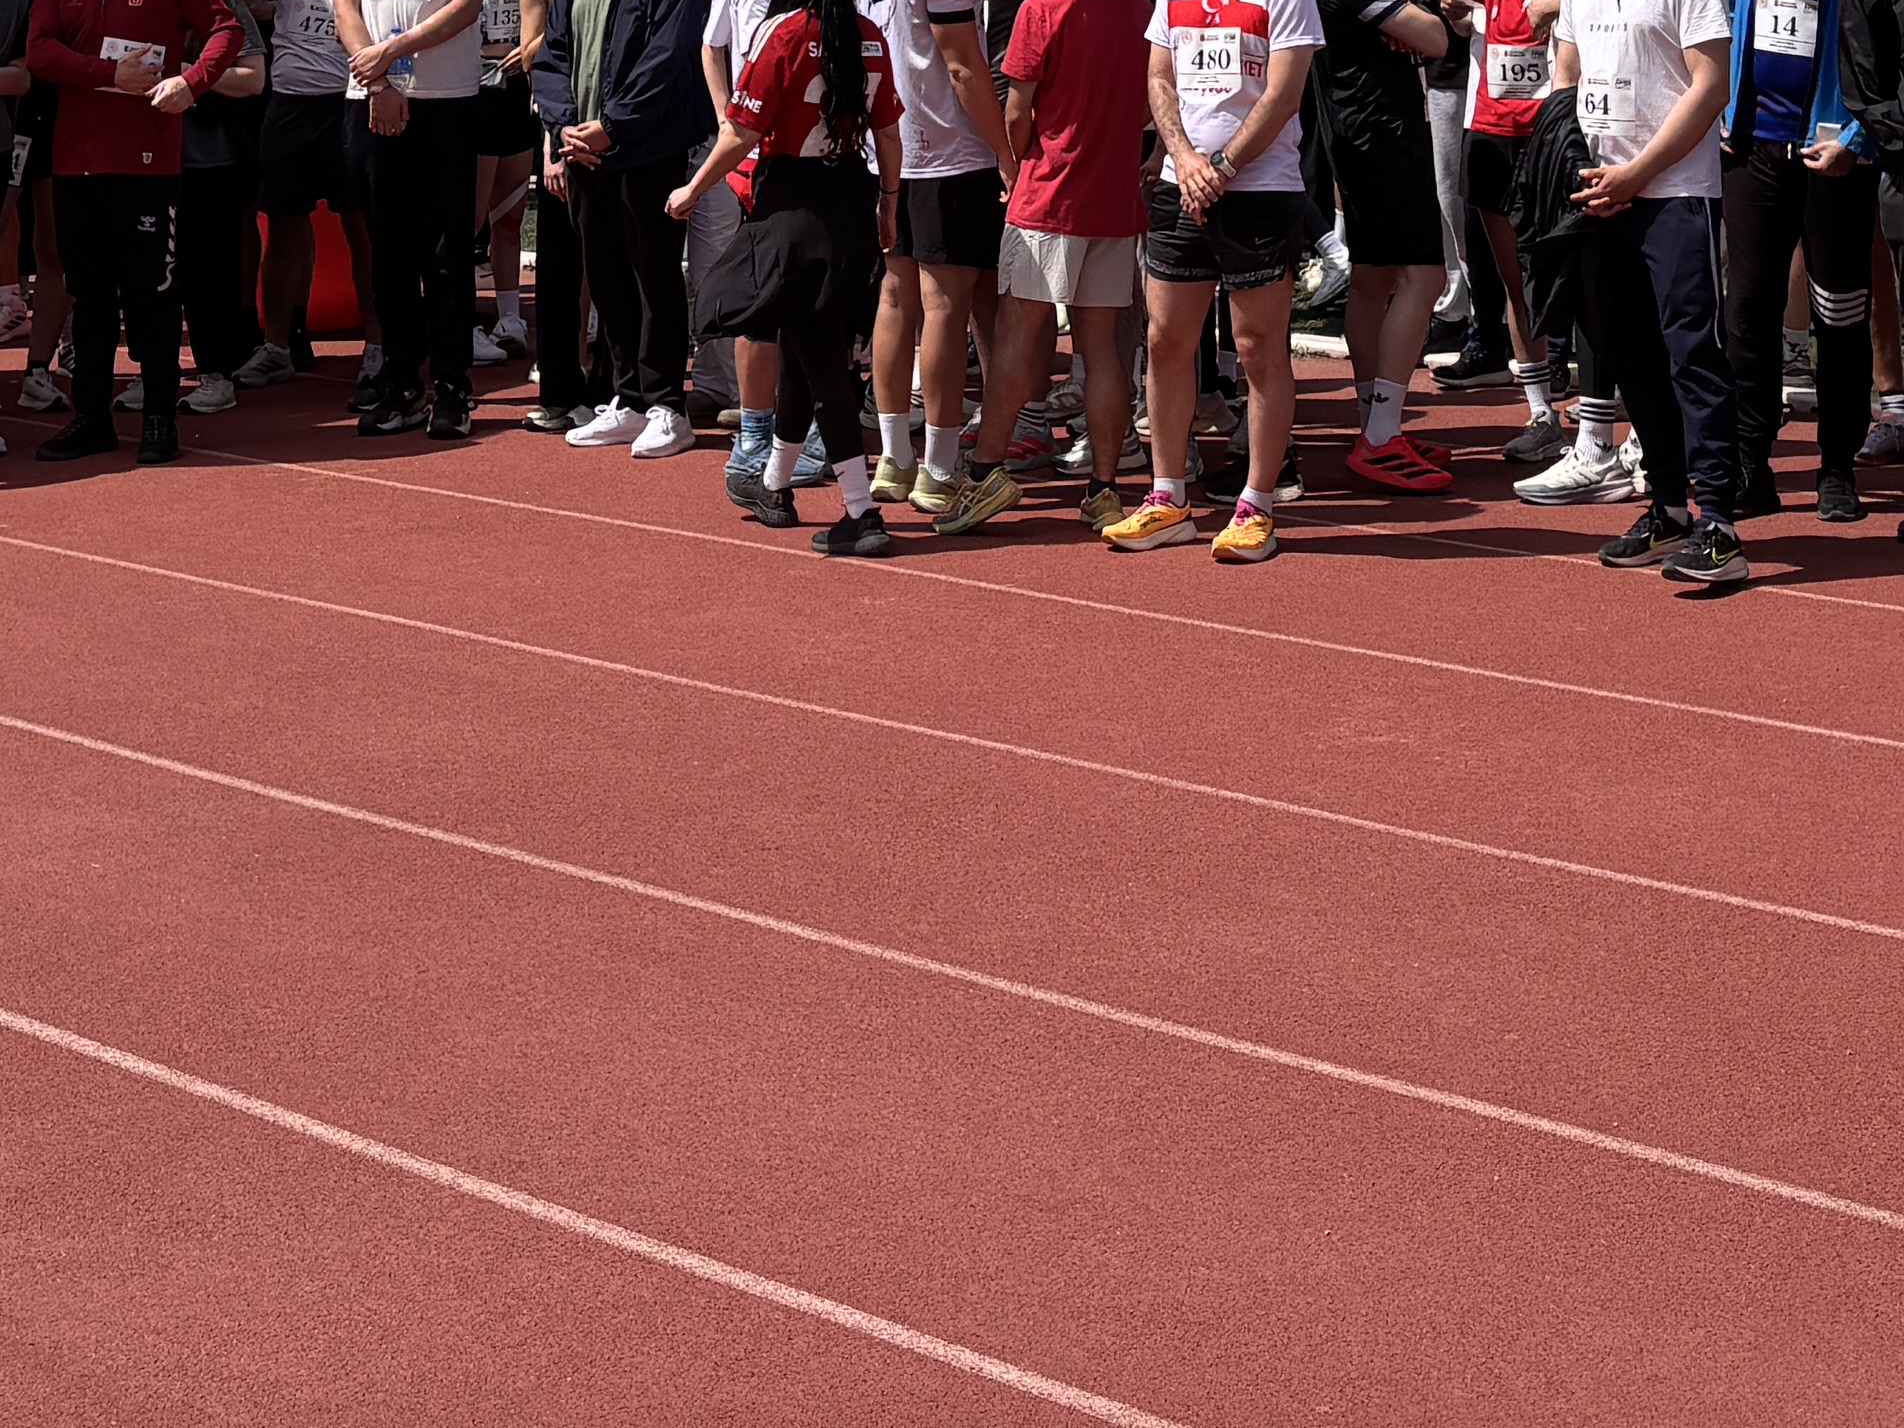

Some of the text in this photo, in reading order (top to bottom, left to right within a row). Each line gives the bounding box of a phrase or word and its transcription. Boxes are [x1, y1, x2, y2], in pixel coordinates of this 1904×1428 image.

[299, 15, 336, 36] 475
[493, 8, 520, 27] 135
[1770, 14, 1799, 37] 14
[1191, 48, 1232, 70] 480
[1499, 63, 1542, 83] 195
[1584, 93, 1612, 115] 64
